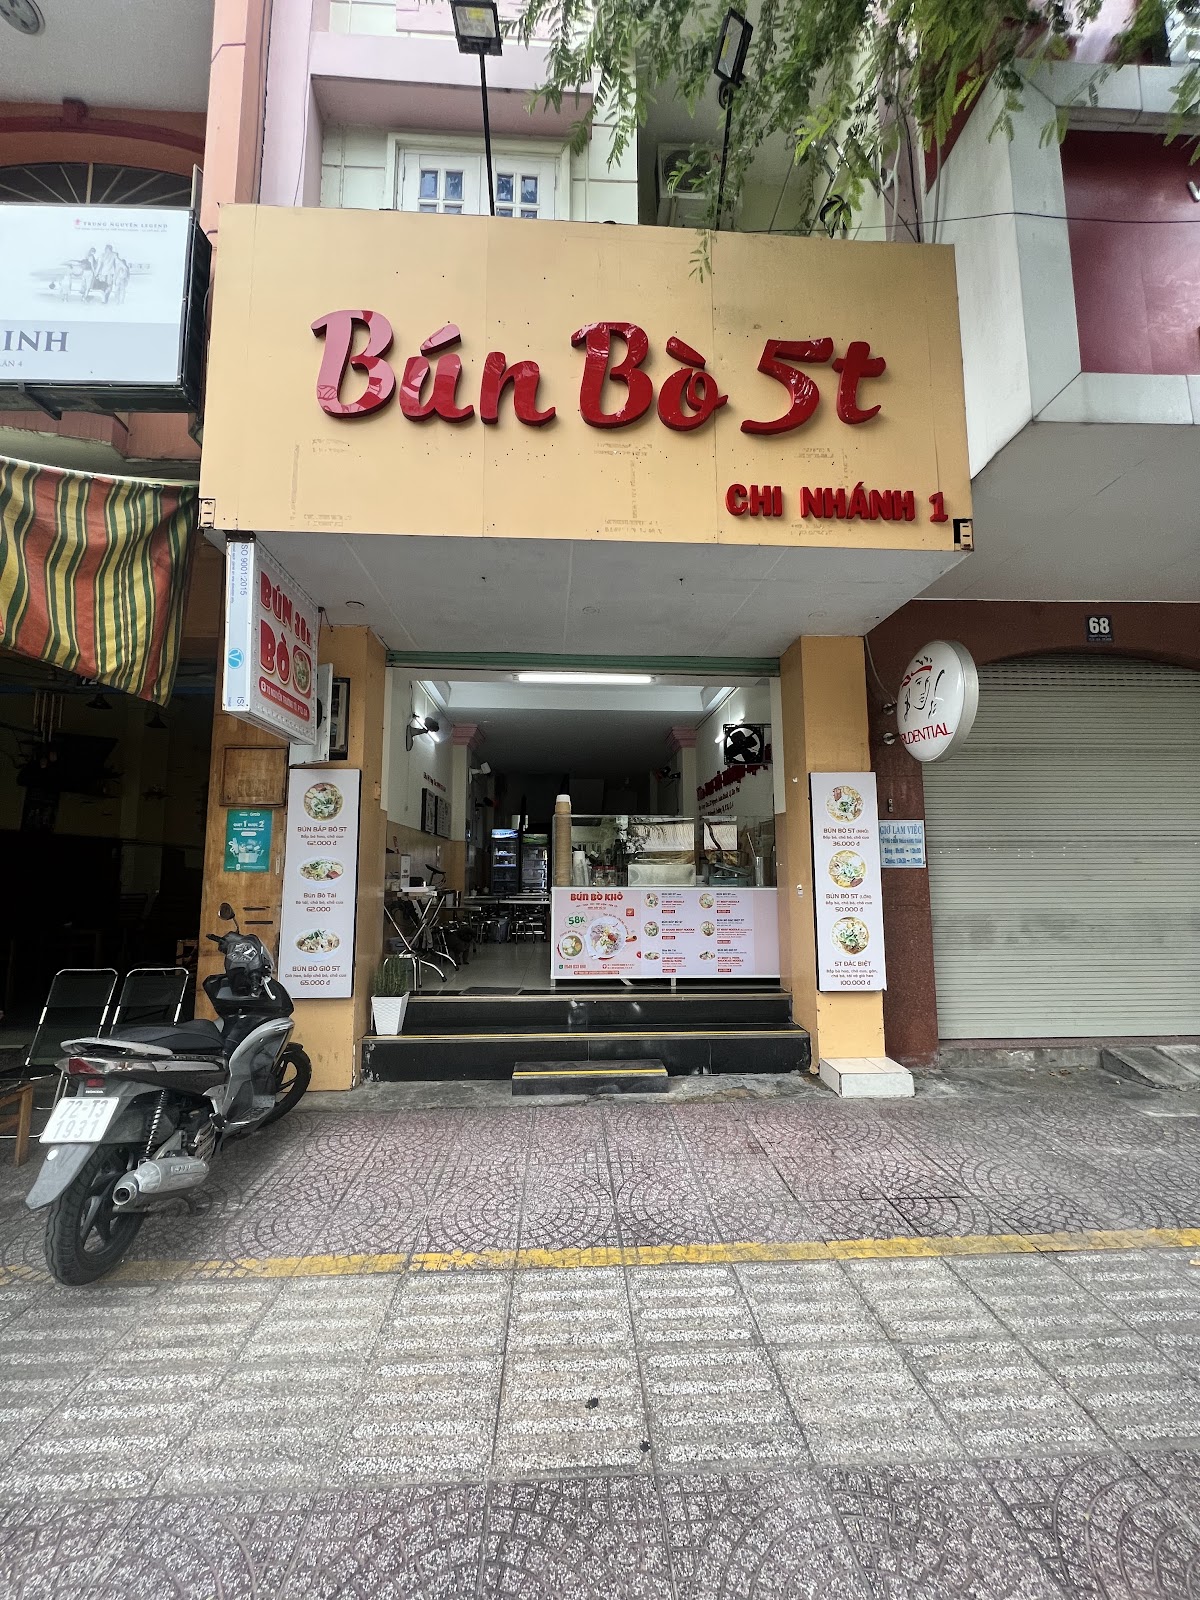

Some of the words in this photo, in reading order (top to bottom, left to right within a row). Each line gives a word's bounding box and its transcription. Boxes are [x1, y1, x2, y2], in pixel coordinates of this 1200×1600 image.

[310, 309, 556, 427] Bún
[571, 322, 728, 432] Bò
[740, 337, 886, 436] 5t
[725, 483, 784, 517] CHI
[800, 481, 916, 522] NHÁNH
[928, 491, 949, 522] 1
[240, 557, 248, 596] 9001:2015
[259, 570, 293, 632] BÚN
[1089, 617, 1110, 634] 68
[259, 618, 290, 684] BÒ
[879, 823, 891, 835] GIỜ
[892, 824, 906, 835] LÀM
[570, 891, 589, 901] BÚN
[590, 891, 603, 901] BÒ
[604, 891, 623, 901] KHÔ
[292, 964, 307, 972] BÚN
[308, 964, 318, 972] BÒ
[857, 960, 872, 968] BIỆT
[60, 1100, 108, 1119] 72-T3
[53, 1119, 99, 1139] 1931
